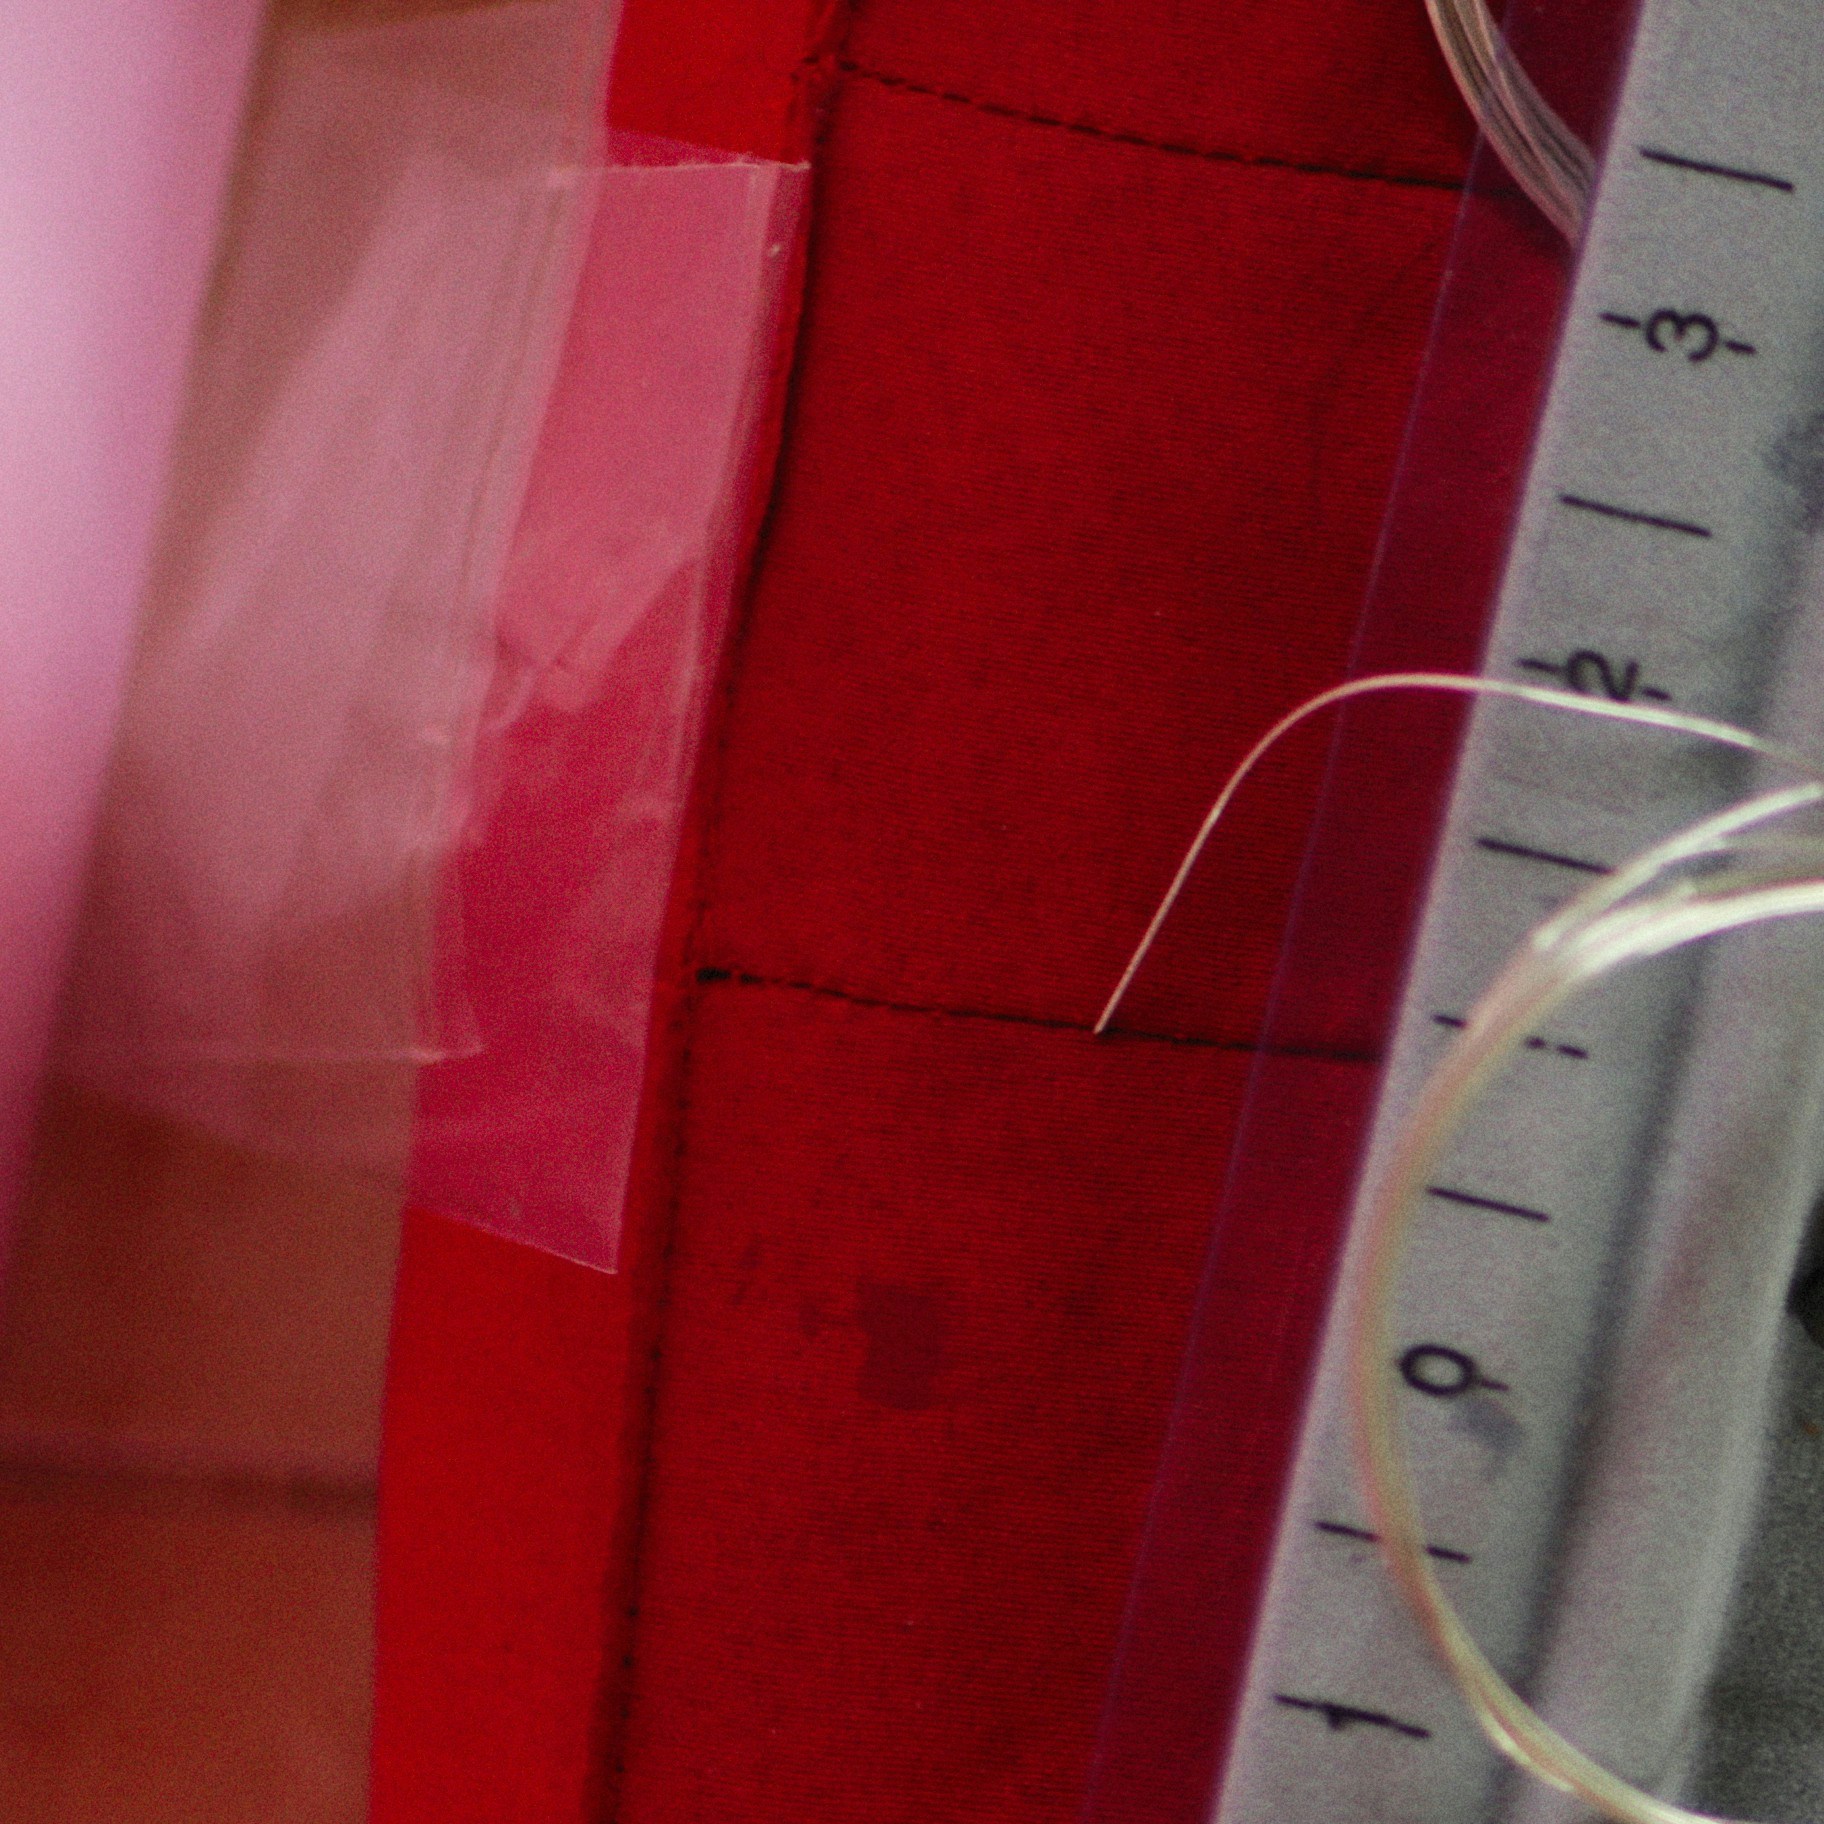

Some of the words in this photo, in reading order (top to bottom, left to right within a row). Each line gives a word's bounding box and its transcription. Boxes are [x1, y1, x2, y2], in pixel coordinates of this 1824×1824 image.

[1643, 306, 1722, 363] 3
[1565, 648, 1640, 703] 2
[1402, 1344, 1476, 1396] 0
